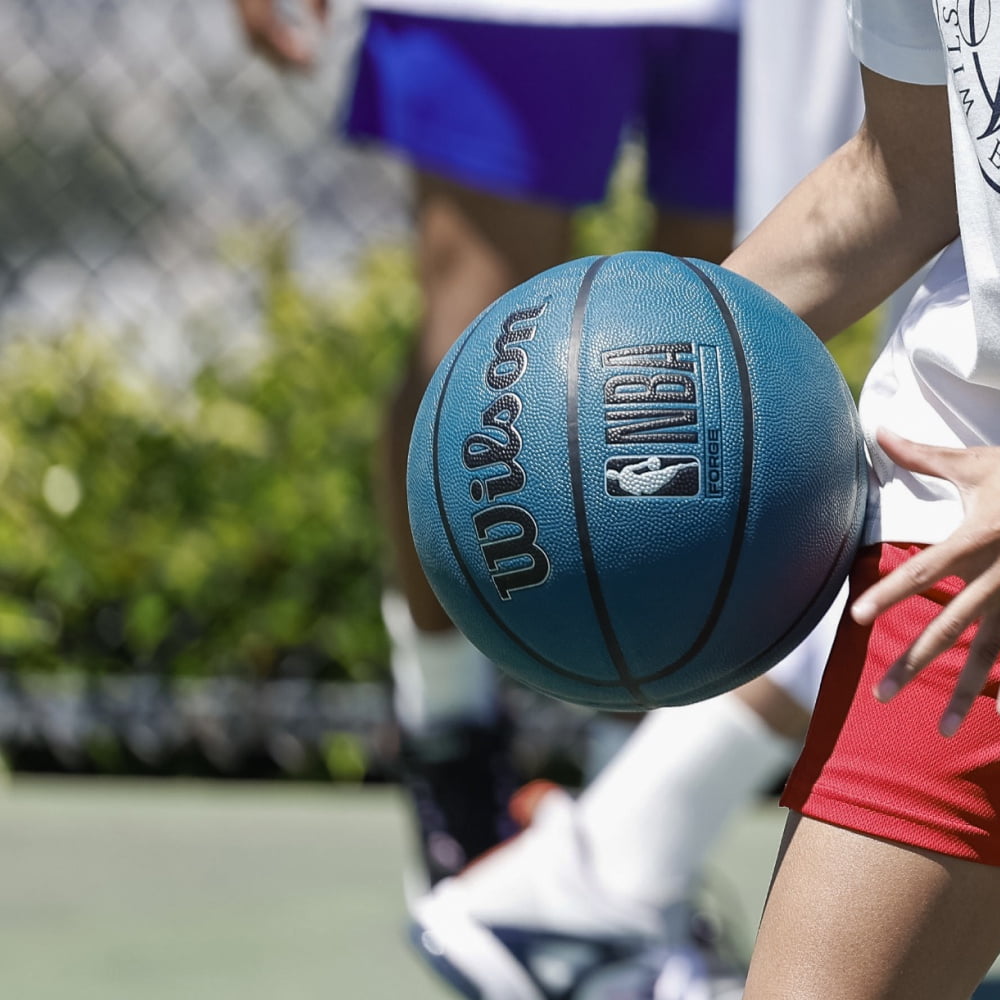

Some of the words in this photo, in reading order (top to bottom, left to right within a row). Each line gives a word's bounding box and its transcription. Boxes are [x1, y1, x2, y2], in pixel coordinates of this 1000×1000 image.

[602, 342, 698, 446] NBA
[462, 300, 551, 601] Wilson
[708, 428, 721, 495] FORGE
